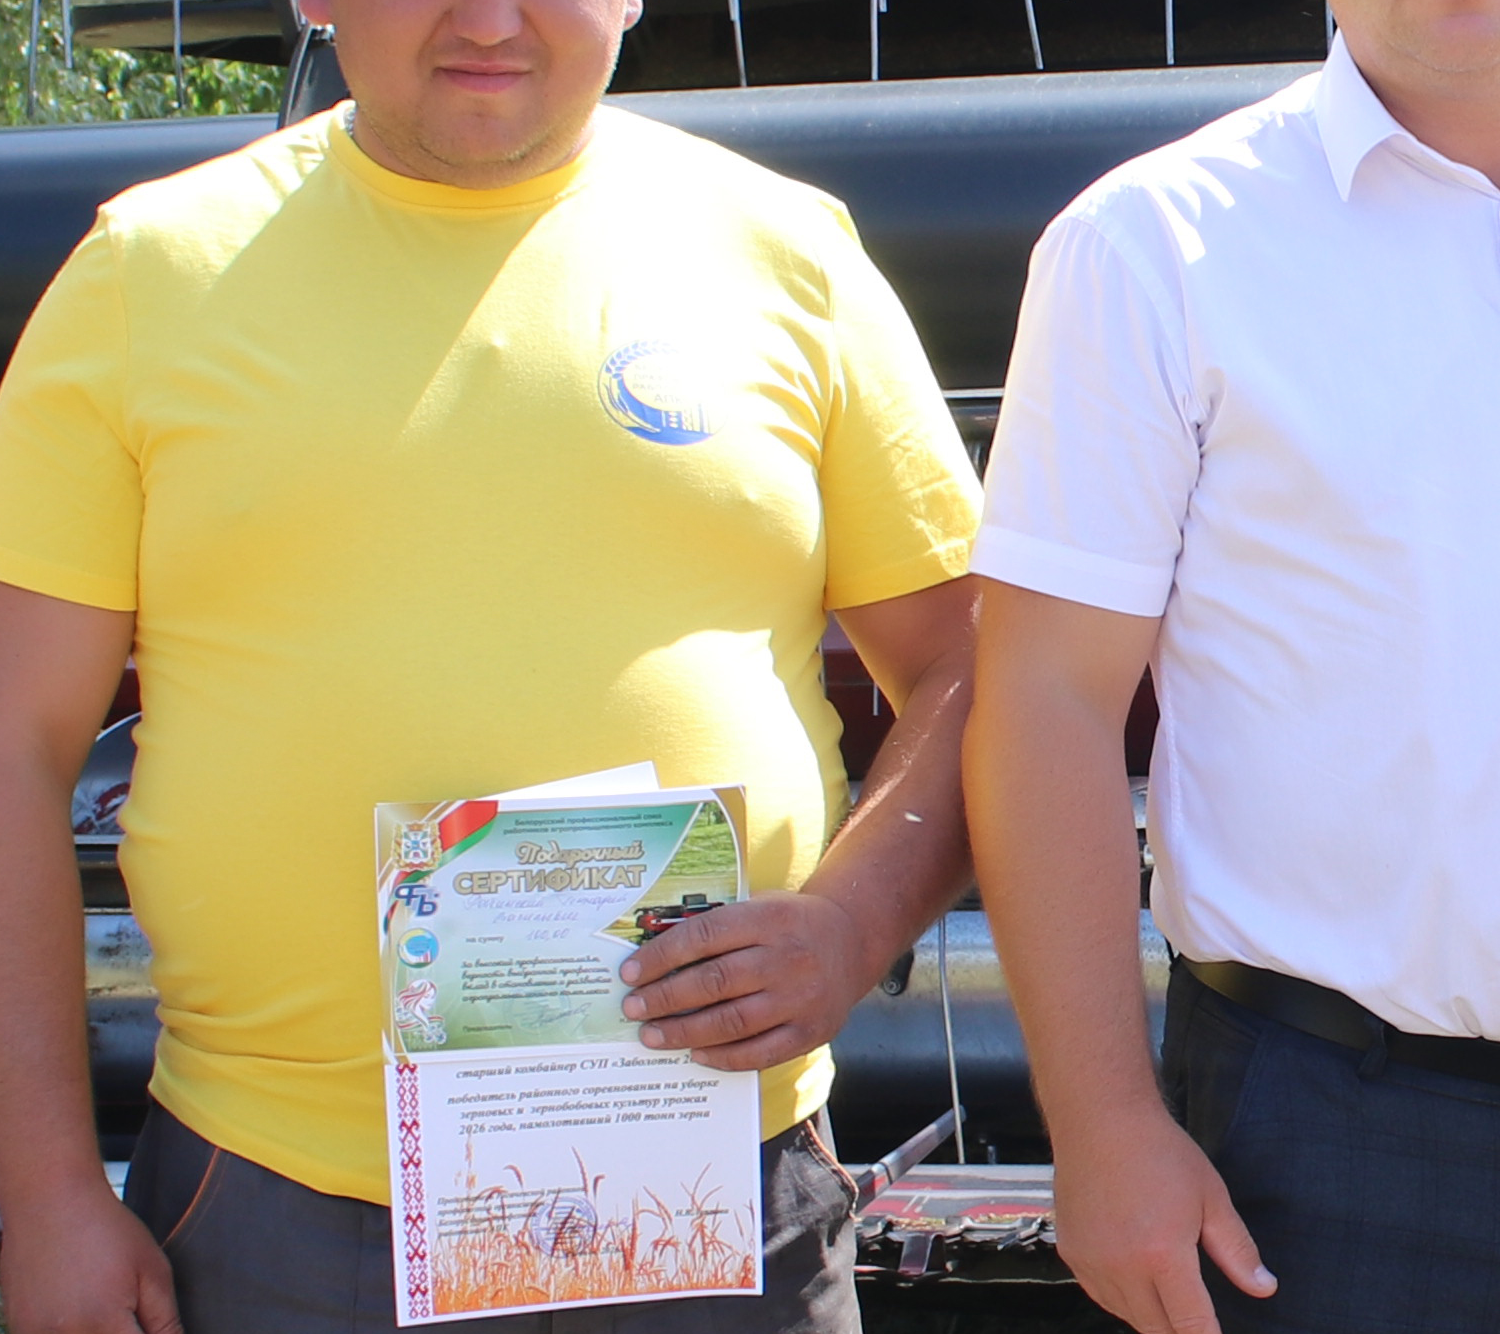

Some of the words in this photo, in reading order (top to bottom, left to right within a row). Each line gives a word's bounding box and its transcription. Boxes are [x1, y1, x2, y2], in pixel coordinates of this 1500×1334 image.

[516, 840, 645, 868] Подарочный
[453, 865, 646, 895] СЕРТИФИКАТ
[456, 1065, 512, 1080] старший
[514, 1061, 577, 1076] комбайнер
[580, 1058, 609, 1071] СУП
[611, 1055, 680, 1069] «Заболотье
[447, 1091, 517, 1105] победитель
[518, 1085, 580, 1102] районного
[582, 1082, 661, 1096] соревнования
[664, 1081, 678, 1090] на
[680, 1077, 720, 1093] уборке
[460, 1107, 514, 1121] зерновых
[517, 1107, 524, 1115] и
[530, 1100, 611, 1116] зернобобовых
[612, 1098, 660, 1112] культур
[663, 1095, 708, 1109] урожая
[459, 1122, 486, 1135] 2026
[487, 1120, 517, 1134] года,
[519, 1115, 612, 1131] намолотивший
[614, 1112, 642, 1124] 1000
[643, 1112, 676, 1123] тонн
[677, 1109, 710, 1122] зерна
